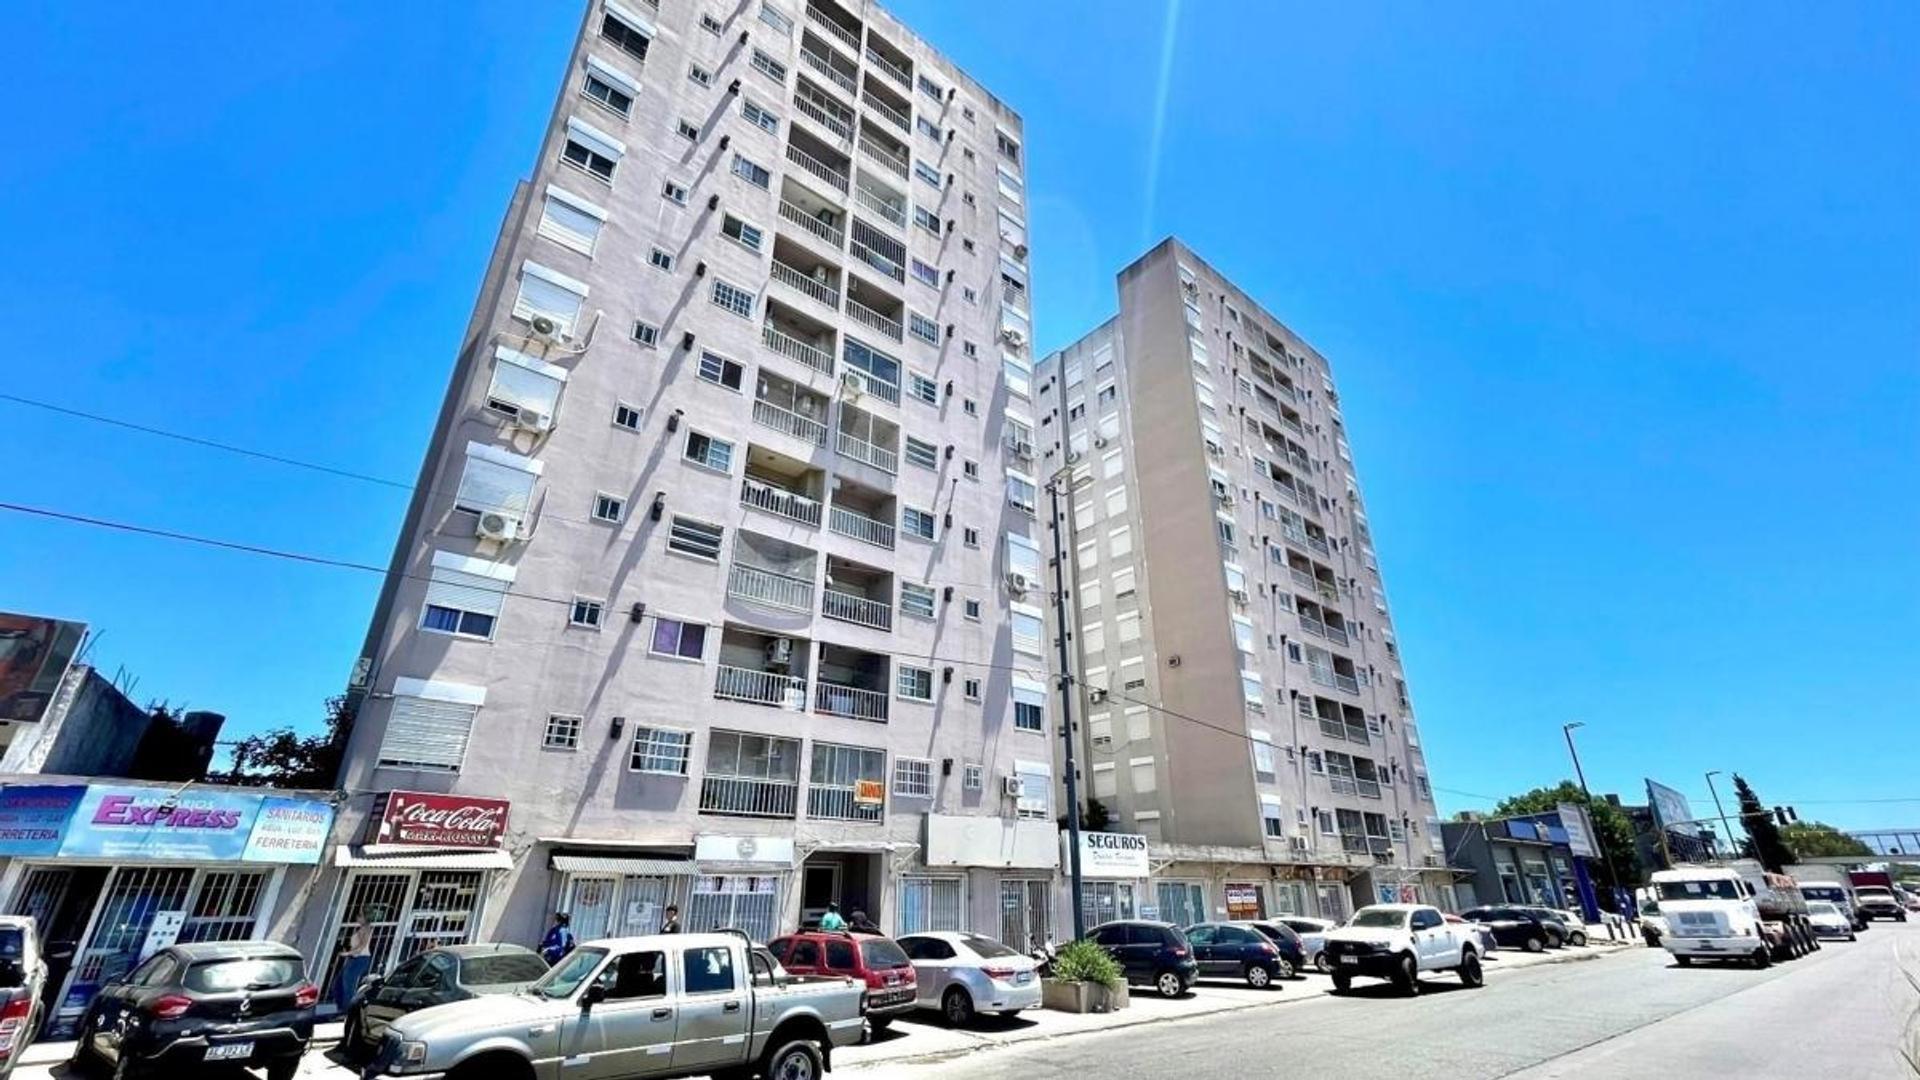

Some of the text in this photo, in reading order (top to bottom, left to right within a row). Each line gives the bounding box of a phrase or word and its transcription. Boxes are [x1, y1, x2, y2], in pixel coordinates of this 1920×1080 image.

[267, 807, 325, 824] SANITARIOS
[255, 836, 318, 850] FERRETERIA
[1087, 833, 1146, 850] SEGUROS
